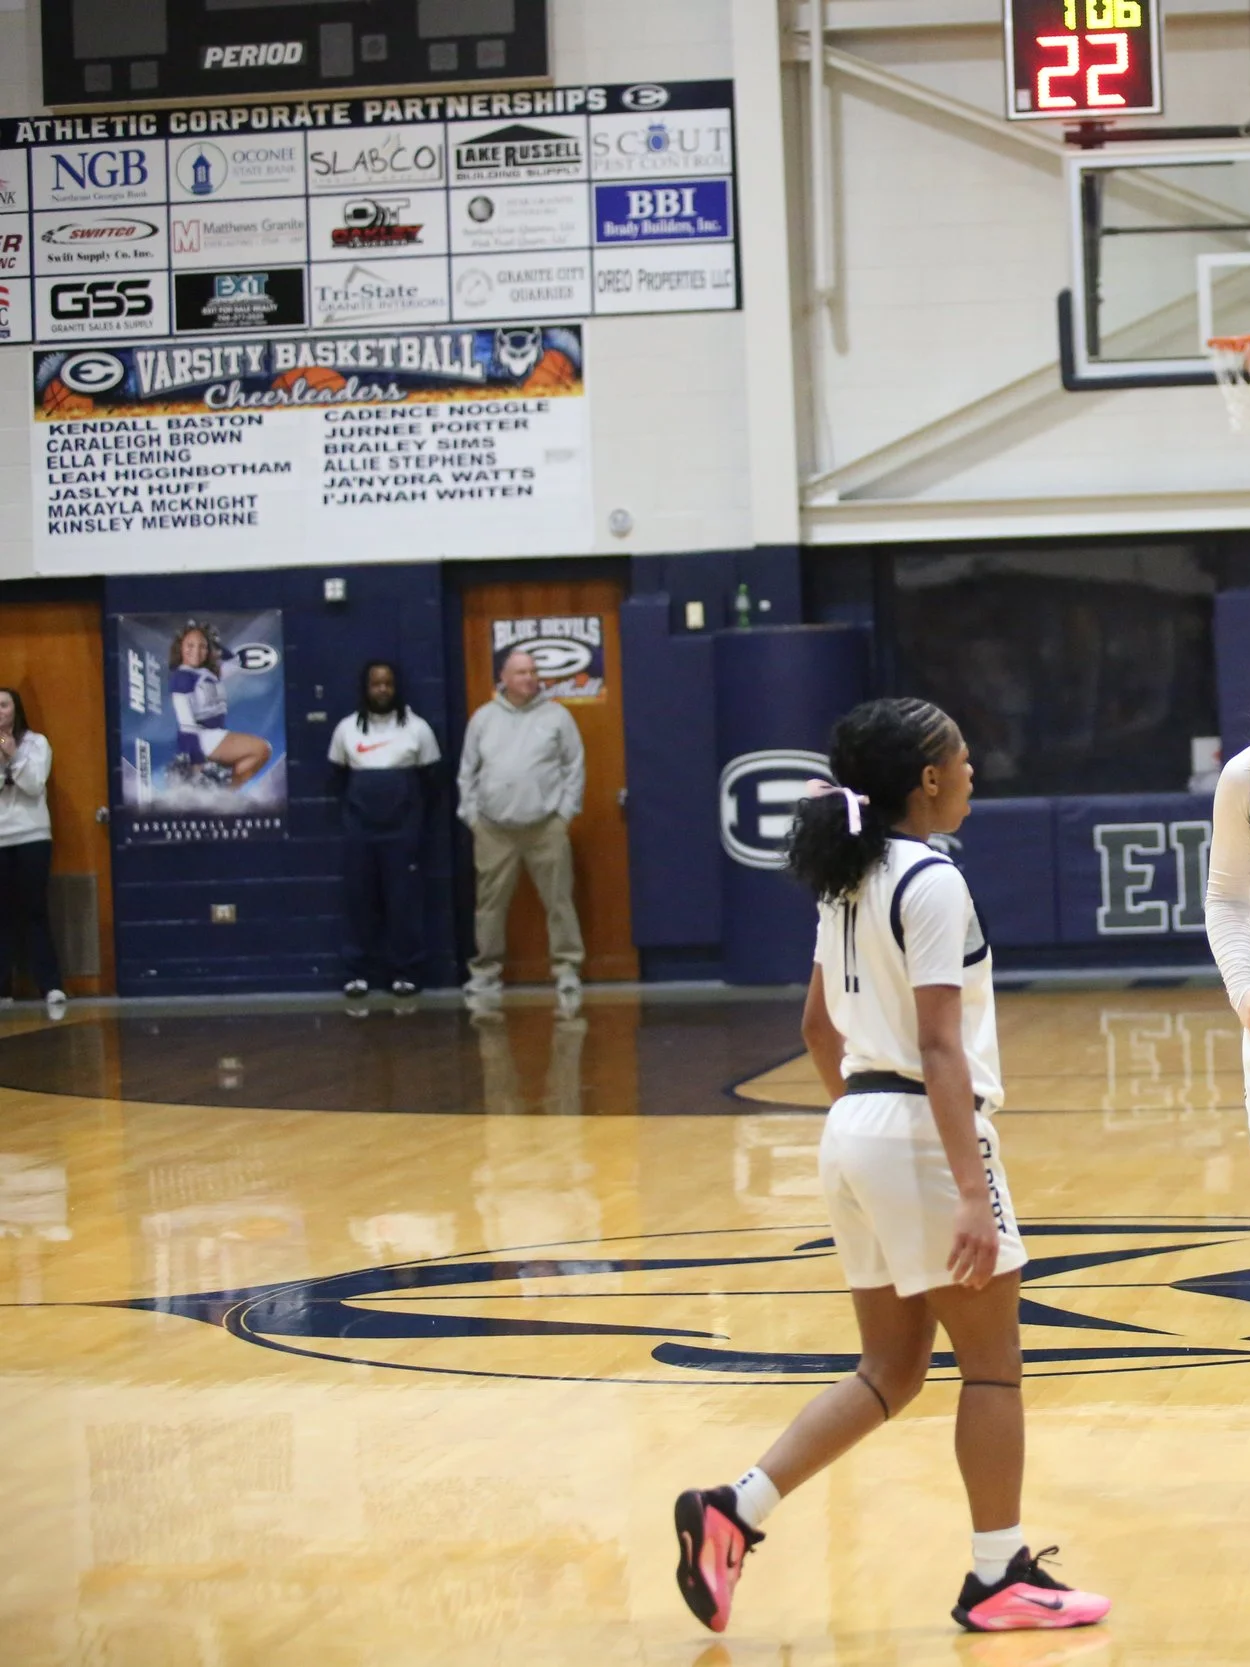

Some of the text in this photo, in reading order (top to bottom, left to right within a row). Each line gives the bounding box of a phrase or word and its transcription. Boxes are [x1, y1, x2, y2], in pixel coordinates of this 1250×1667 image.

[204, 42, 303, 69] PERIOD
[1036, 33, 1129, 109] 22
[15, 88, 607, 144] ATHLETIC CORPORATE PARTNERSHIPS
[310, 146, 436, 176] SLABCO
[456, 143, 581, 169] LAKE RUSSELL
[51, 150, 148, 191] NGB
[626, 188, 697, 219] BBI
[69, 226, 136, 240] SWIFTCO
[47, 252, 73, 263] Swift
[77, 250, 110, 263] Supply
[51, 279, 153, 320] GSS
[316, 283, 419, 301] Tri-State
[135, 334, 486, 395] VARSITY BASKETBALL
[203, 376, 408, 409] Cheerleaders
[324, 399, 551, 423] CADENCE NOGGLE
[49, 414, 264, 436] KENDALL BASTON
[325, 418, 529, 439] JURNEE PORTER
[47, 430, 243, 453] CARALEIGH BROWN
[324, 436, 496, 455] BRAILEY SIMS
[47, 449, 192, 470] ELLA FLEMING
[324, 451, 497, 473] ALLIE STEPHENS
[48, 461, 292, 485] LEAH HIGGINBOTHAM
[324, 467, 536, 489] JA'NYDRA WATTS
[49, 481, 211, 502] JASLYN HUFF
[436, 484, 533, 501] WHITEN
[48, 499, 144, 519] MAKAYLA
[48, 511, 259, 535] KINSLEY MEWBORNE
[494, 617, 600, 652] BLUE DEVILS
[128, 649, 146, 714] HUFF
